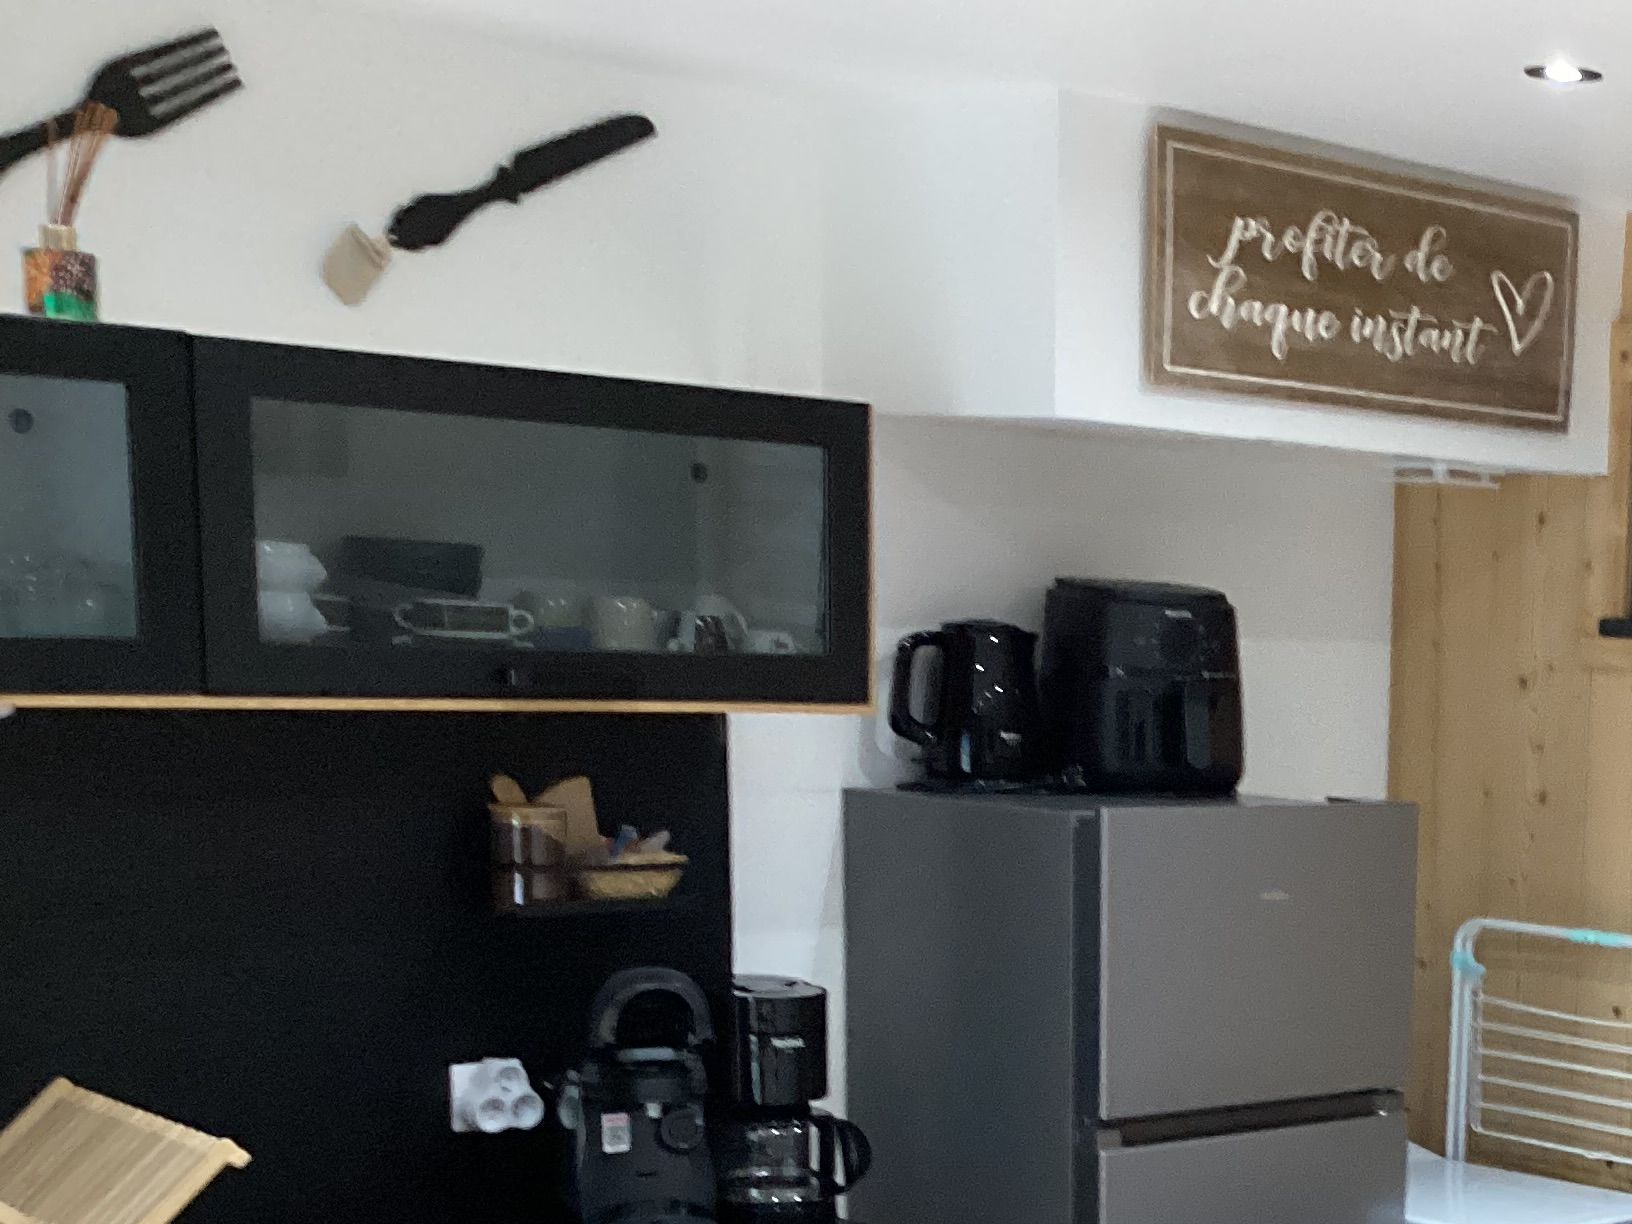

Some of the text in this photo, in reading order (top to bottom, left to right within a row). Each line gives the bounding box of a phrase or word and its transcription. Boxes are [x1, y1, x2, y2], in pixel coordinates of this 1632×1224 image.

[1207, 209, 1453, 282] profiter de
[1188, 265, 1498, 364] chaque instant
